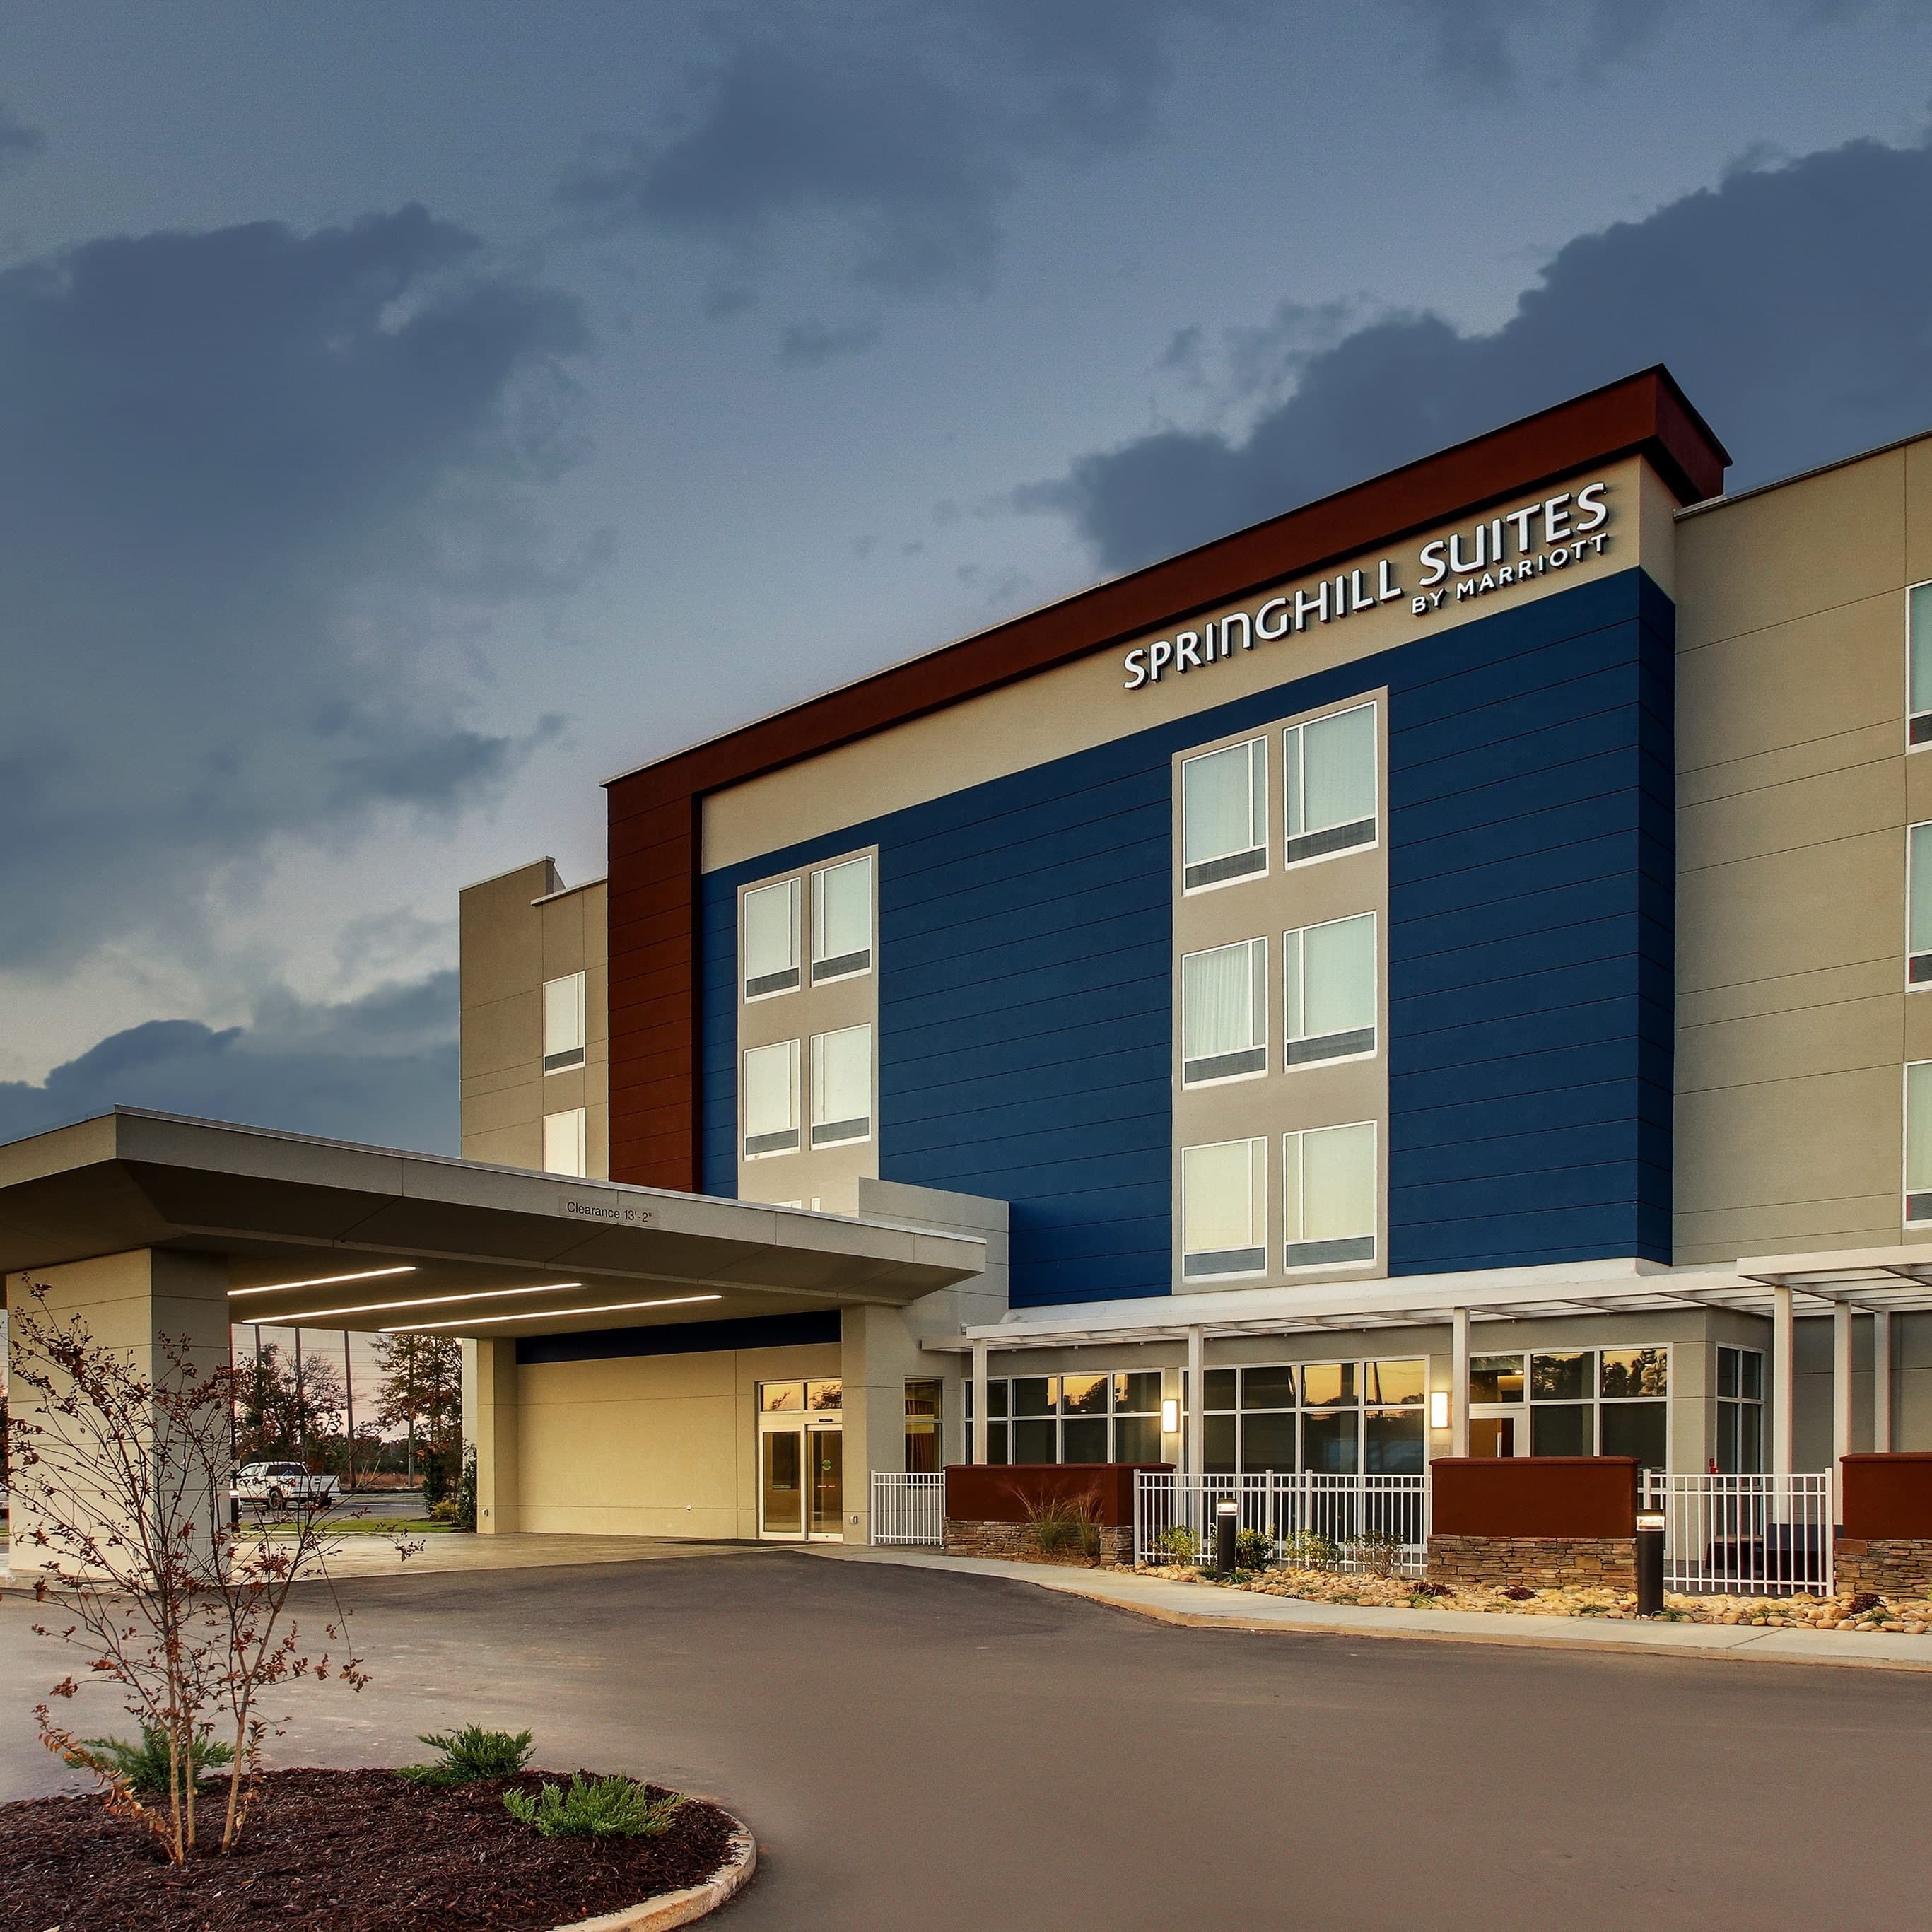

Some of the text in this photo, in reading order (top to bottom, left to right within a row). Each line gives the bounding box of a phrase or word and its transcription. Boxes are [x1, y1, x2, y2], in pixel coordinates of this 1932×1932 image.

[1123, 482, 1609, 690] SPRINGHILL SUITES
[1411, 532, 1608, 616] BY MARRIOTT
[566, 1201, 620, 1219] Clearance
